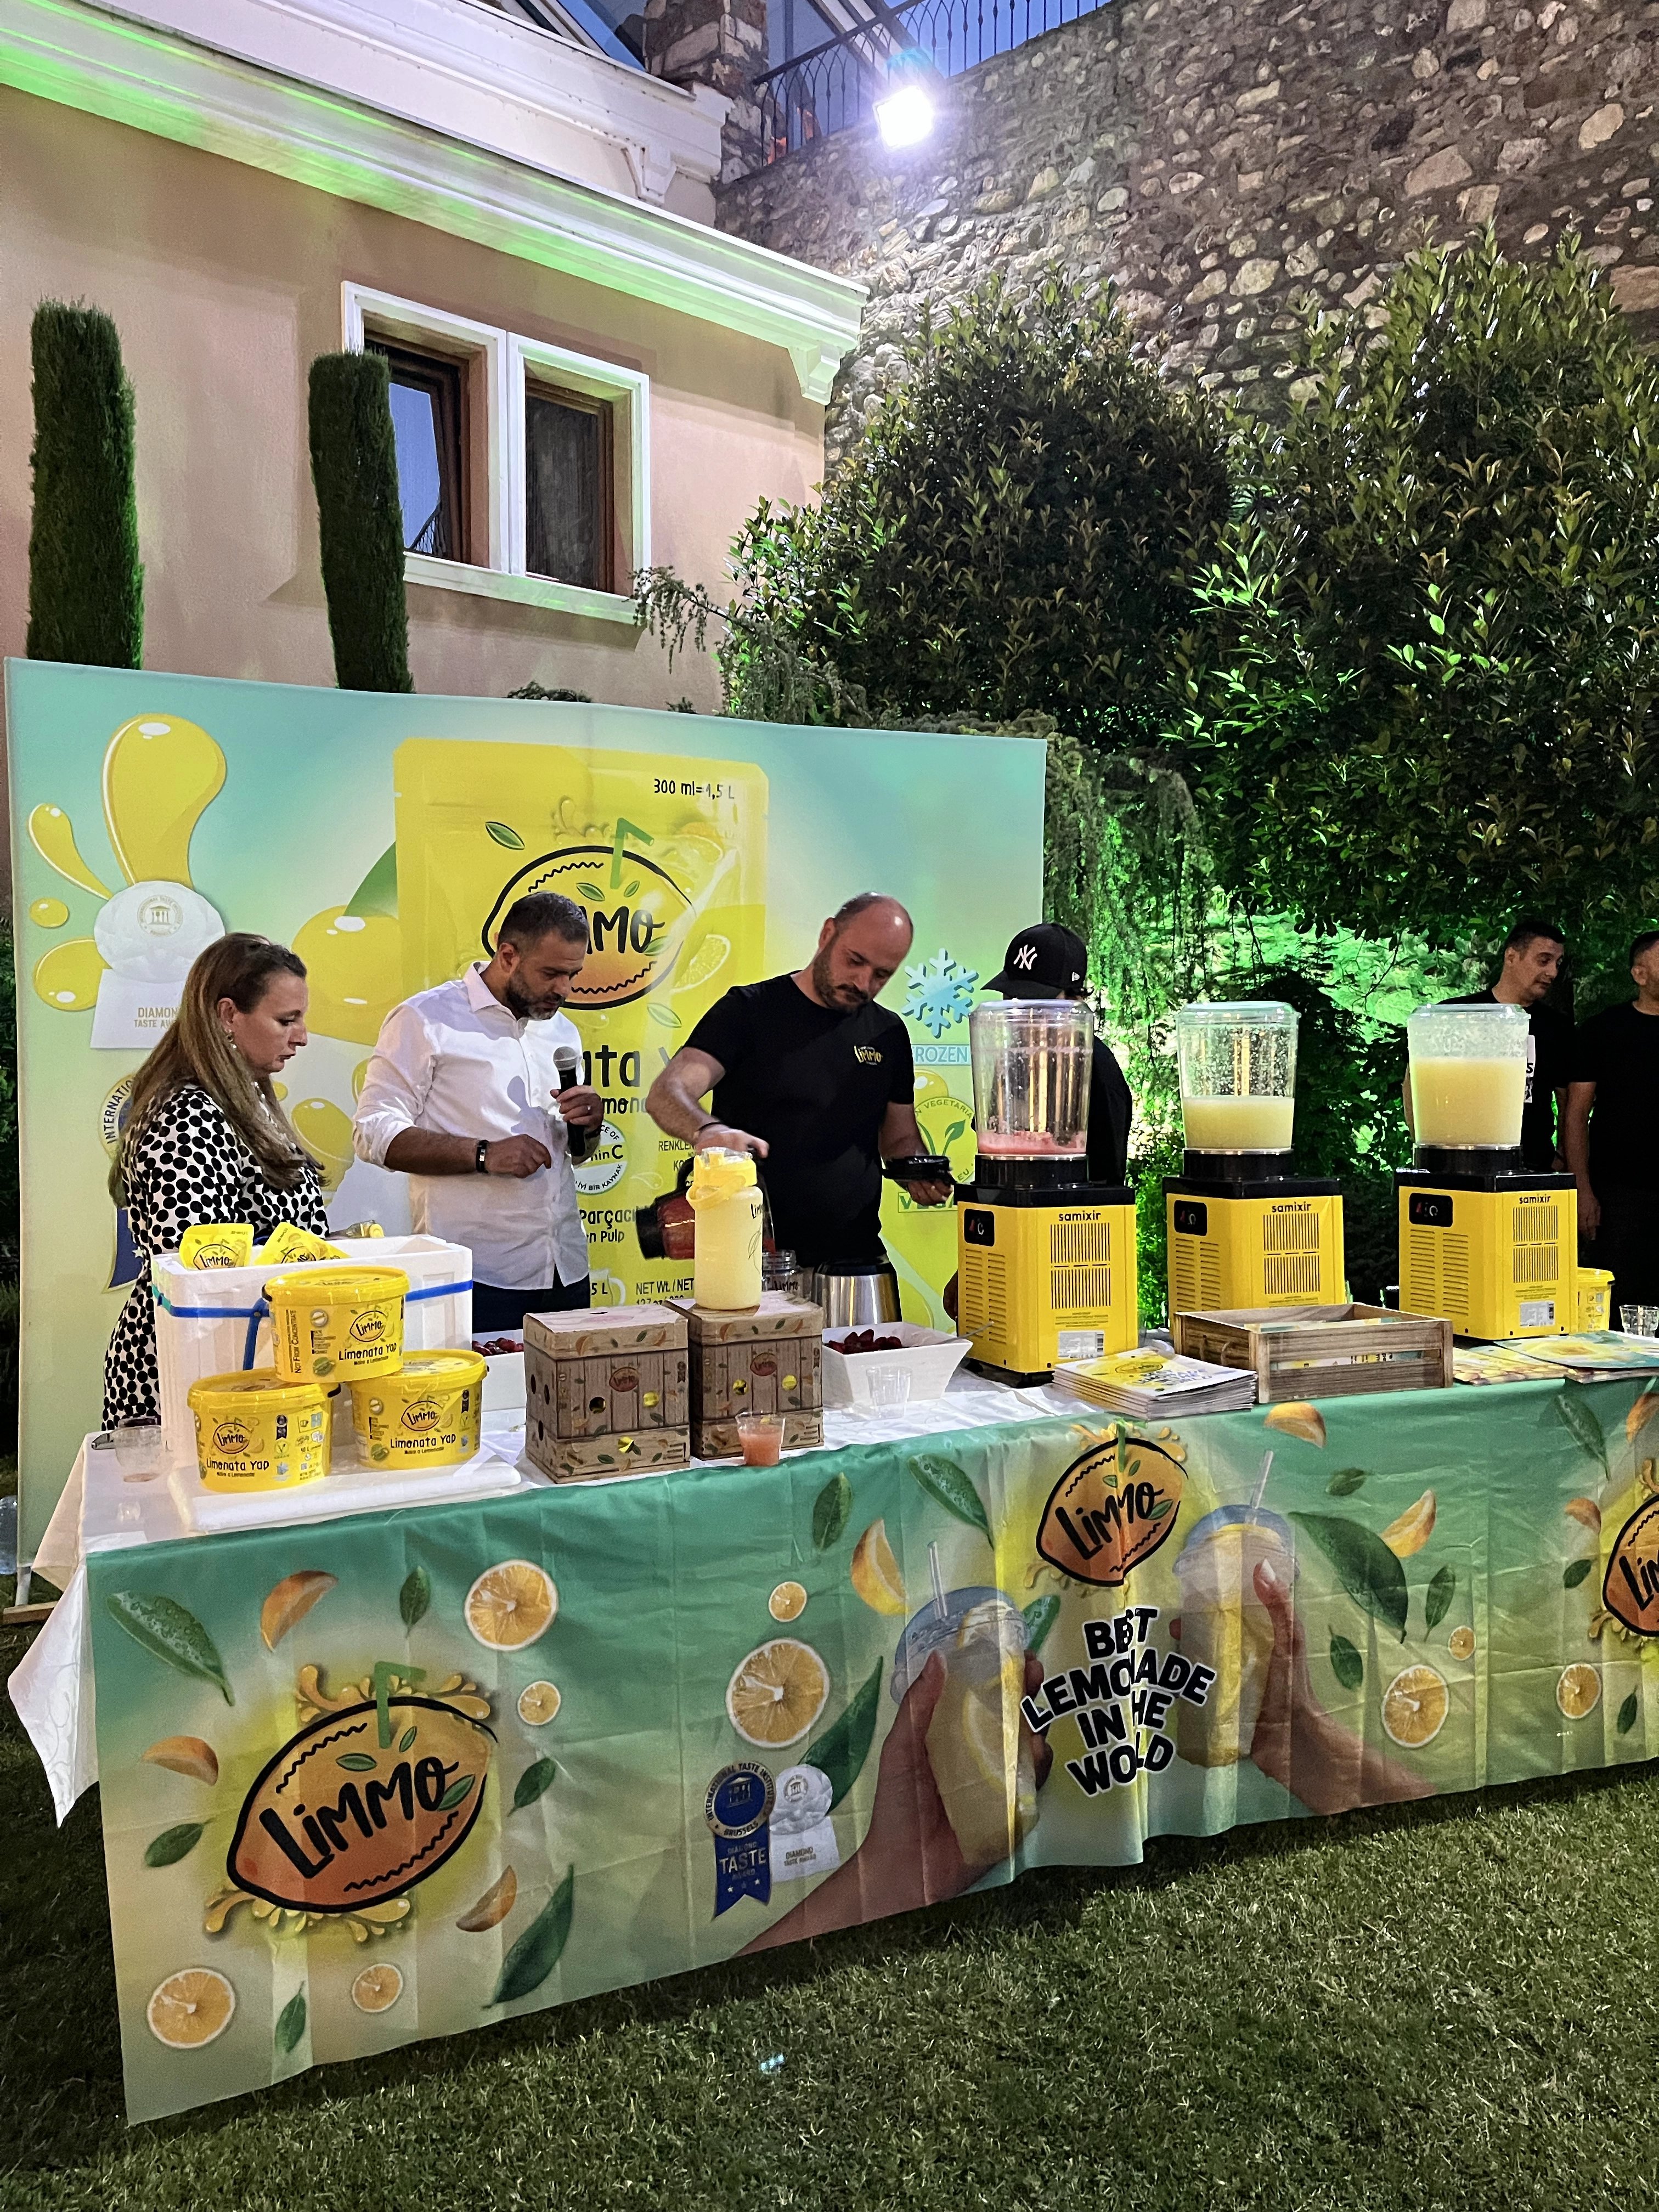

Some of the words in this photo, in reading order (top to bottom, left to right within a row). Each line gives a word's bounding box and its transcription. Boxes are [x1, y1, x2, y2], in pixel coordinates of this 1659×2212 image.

[654, 778, 676, 794] 300
[728, 785, 735, 799] L
[1013, 944, 1037, 970] NY
[138, 1007, 179, 1018] DIAMON
[134, 1019, 157, 1028] TASTE
[912, 1046, 967, 1063] ROZEN
[103, 1080, 134, 1144] INTERNATIO
[924, 1099, 972, 1119] VEGETARIA
[611, 1144, 624, 1159] C
[658, 1139, 695, 1152] RENKLE
[1519, 1193, 1551, 1204] samixir
[1272, 1201, 1312, 1213] samixir
[1059, 1210, 1101, 1222] samixir
[602, 1282, 608, 1295] L
[636, 1282, 654, 1295] NET
[338, 1347, 383, 1361] Limonata
[390, 1437, 437, 1448] Limonata
[441, 1434, 456, 1444] Yap
[206, 1457, 247, 1471] Limonata
[250, 1460, 270, 1471] Yap
[1077, 1704, 1127, 1748] IN
[738, 1762, 760, 1773] TASTE
[723, 1821, 759, 1836] BRUSSELS
[719, 1847, 766, 1875] TASTE
